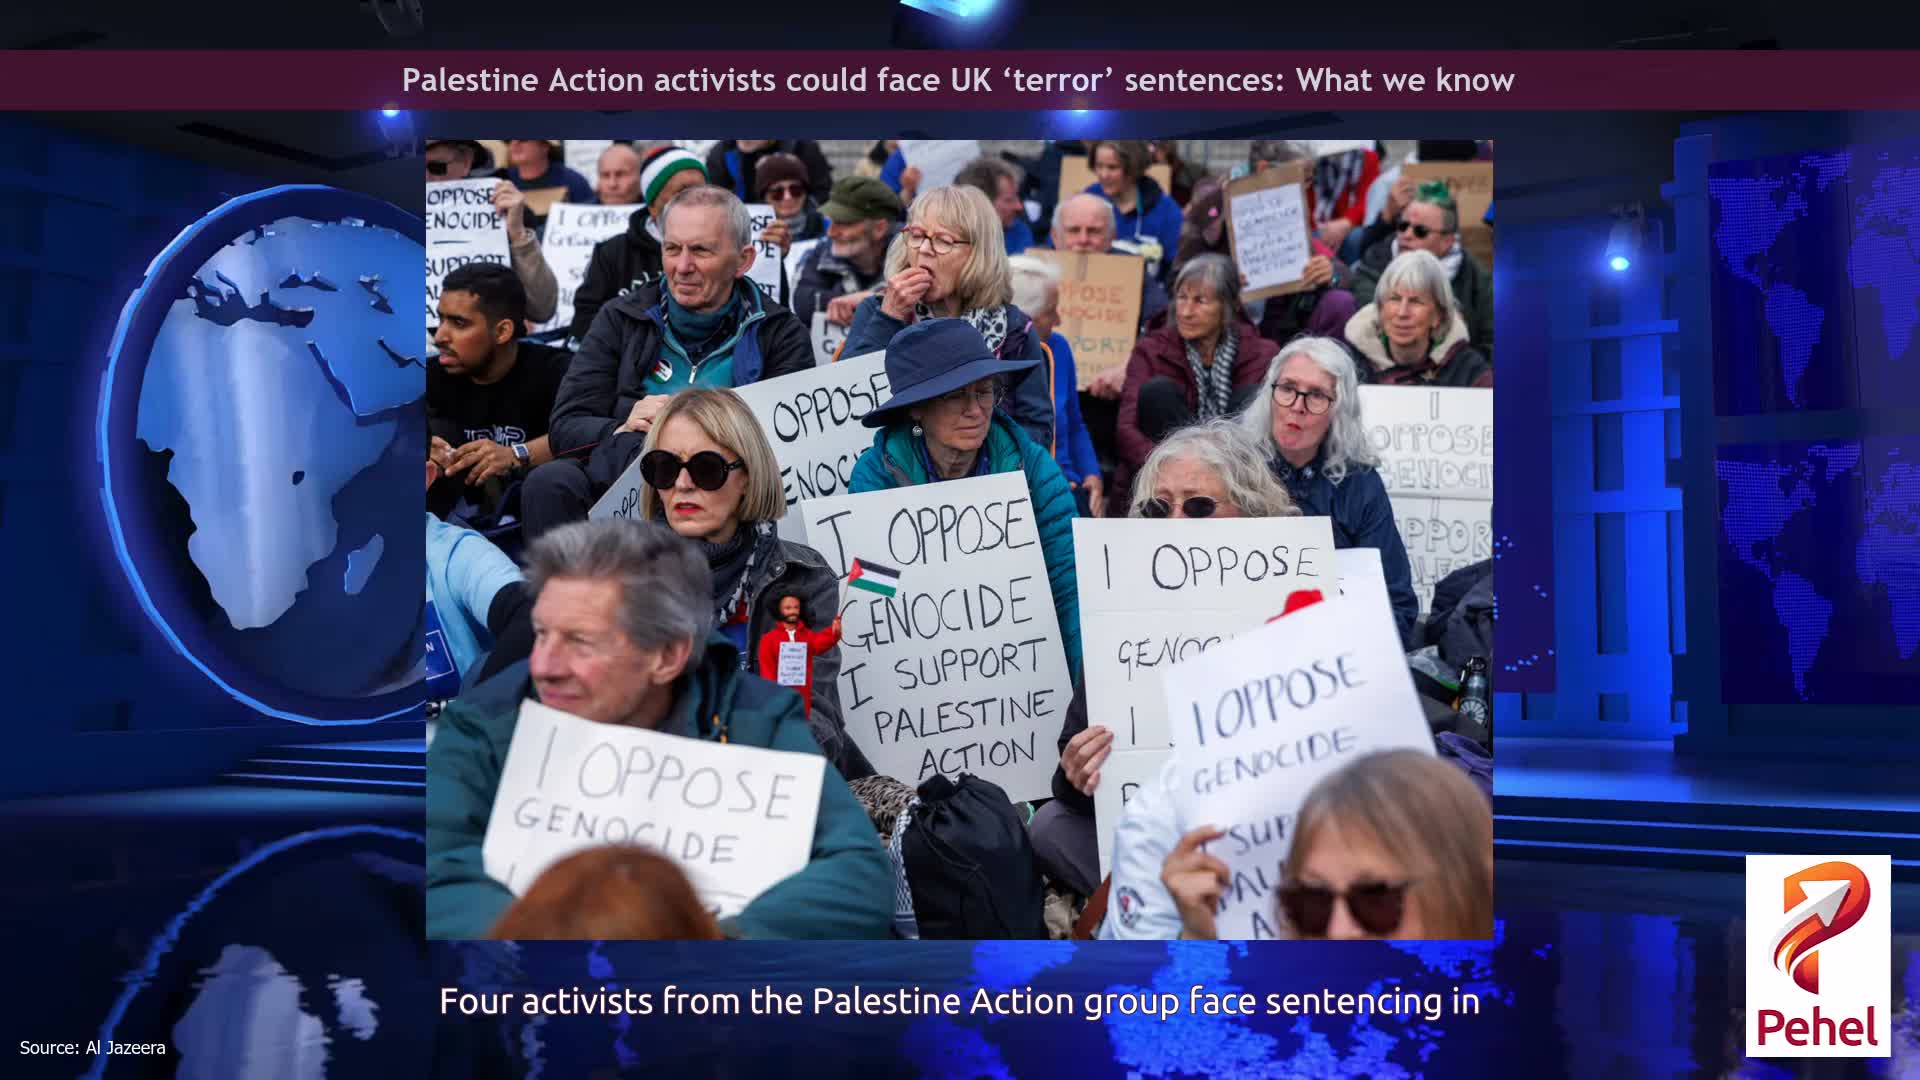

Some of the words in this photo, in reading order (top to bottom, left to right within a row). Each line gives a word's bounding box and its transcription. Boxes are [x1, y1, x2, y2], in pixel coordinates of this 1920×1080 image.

[816, 510, 852, 580] I
[888, 497, 1036, 565] OPPOSE
[1104, 543, 1111, 590] I
[1151, 543, 1320, 591] OPPOSE
[840, 575, 1034, 653] GENOCIDE
[841, 662, 874, 711] I
[893, 637, 1048, 690] SUPPORT
[1192, 700, 1206, 746] I
[1215, 652, 1368, 740] OPPOSE
[874, 689, 1055, 744] PALESTINE
[537, 725, 558, 790] I
[578, 742, 798, 821] OPPOSE
[918, 731, 1036, 781] ACTION
[1192, 726, 1360, 796] GENOCIDE
[513, 797, 740, 864] GENOCIDE
